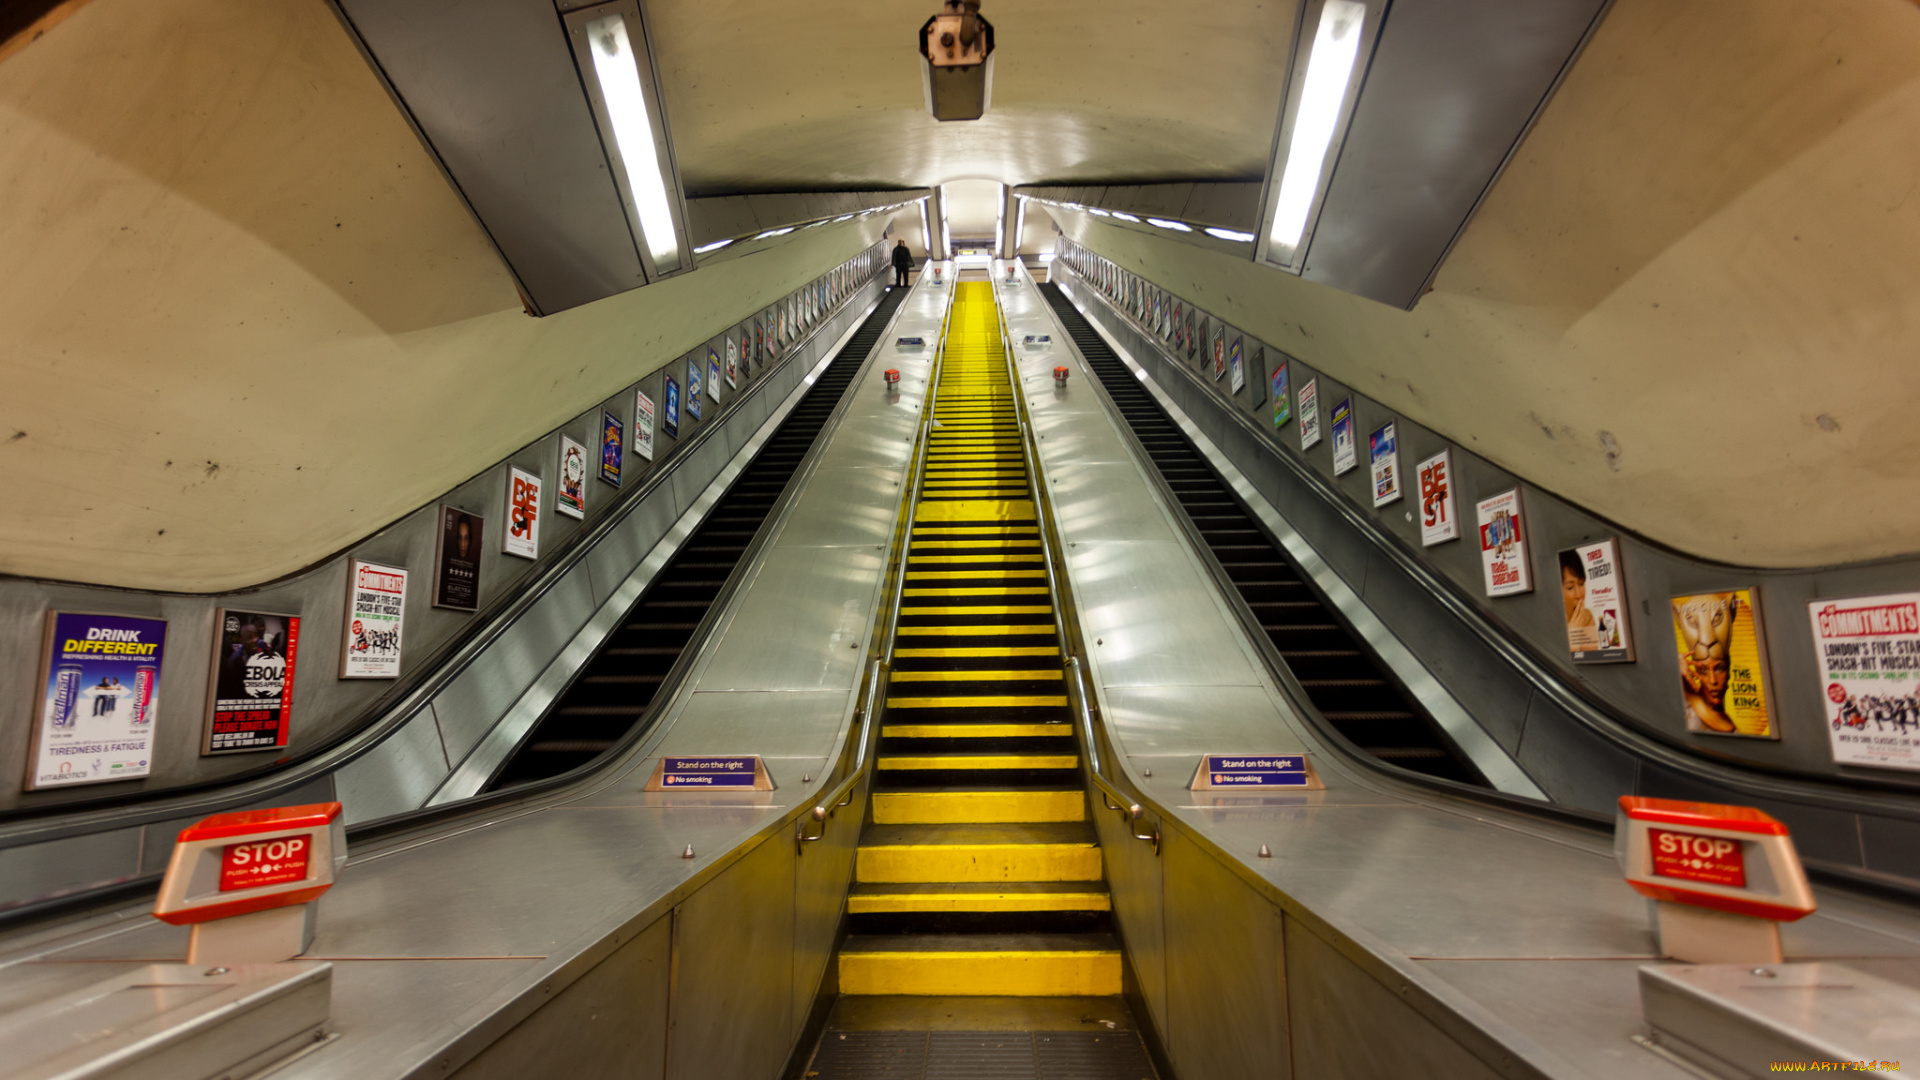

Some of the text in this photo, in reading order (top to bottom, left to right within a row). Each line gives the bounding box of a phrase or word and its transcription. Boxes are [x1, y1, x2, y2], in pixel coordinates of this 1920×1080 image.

[359, 571, 403, 593] COMMITMENTS
[1819, 604, 1918, 637] COMMITMENTS
[86, 627, 142, 642] DRINK
[63, 639, 158, 655] DIFFERENT
[1824, 642, 1870, 657] LONDON'S
[62, 653, 103, 661] REFRESHING
[1827, 657, 1876, 671] SMASH-HIT
[245, 666, 285, 681] EBOLA
[1732, 669, 1751, 679] THE
[1731, 682, 1757, 693] LION
[54, 673, 70, 727] wellman
[133, 672, 146, 724] wellwoman
[1733, 697, 1760, 708] KING
[215, 710, 271, 722] STOP THE SPREAD
[213, 720, 278, 733] PLEASE DONATE NOW
[49, 744, 102, 756] TIREDNESS
[103, 744, 109, 752] &
[111, 742, 146, 751] FATIGUE
[677, 761, 699, 769] Stand
[711, 761, 724, 769] the
[725, 761, 743, 770] right
[1222, 760, 1245, 768] Stand
[1257, 760, 1271, 768] the
[1273, 760, 1292, 769] right
[40, 771, 88, 781] VITABIOTICS
[686, 776, 712, 784] smoking
[1235, 775, 1262, 783] smoking
[232, 839, 303, 865] STOP
[1658, 833, 1734, 859] STOP
[284, 861, 305, 869] PUSH
[226, 869, 248, 877] PUSH
